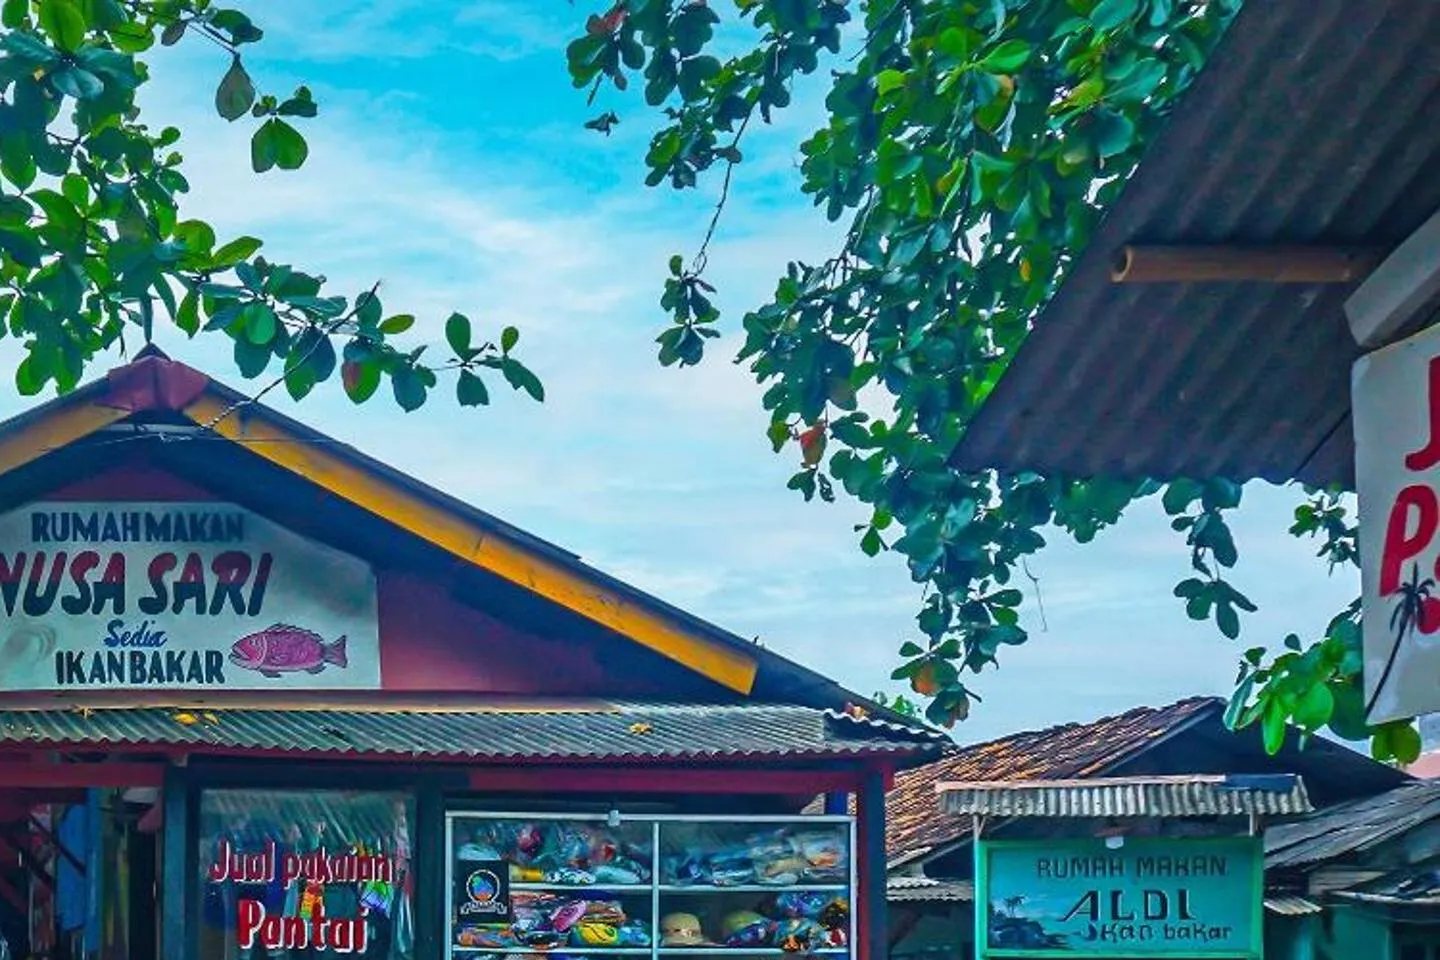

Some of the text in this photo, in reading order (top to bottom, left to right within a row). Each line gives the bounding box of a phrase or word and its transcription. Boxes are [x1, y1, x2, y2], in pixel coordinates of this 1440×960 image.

[31, 511, 245, 543] RUMAH MAKAN
[136, 550, 275, 618] SARI
[103, 619, 168, 648] Sedia
[55, 650, 226, 685] IKAN BAKAR
[210, 837, 276, 883] Jual
[1036, 855, 1227, 878] RUMAH MAKAN
[1059, 888, 1197, 923] ALDI
[238, 897, 369, 954] Pantai
